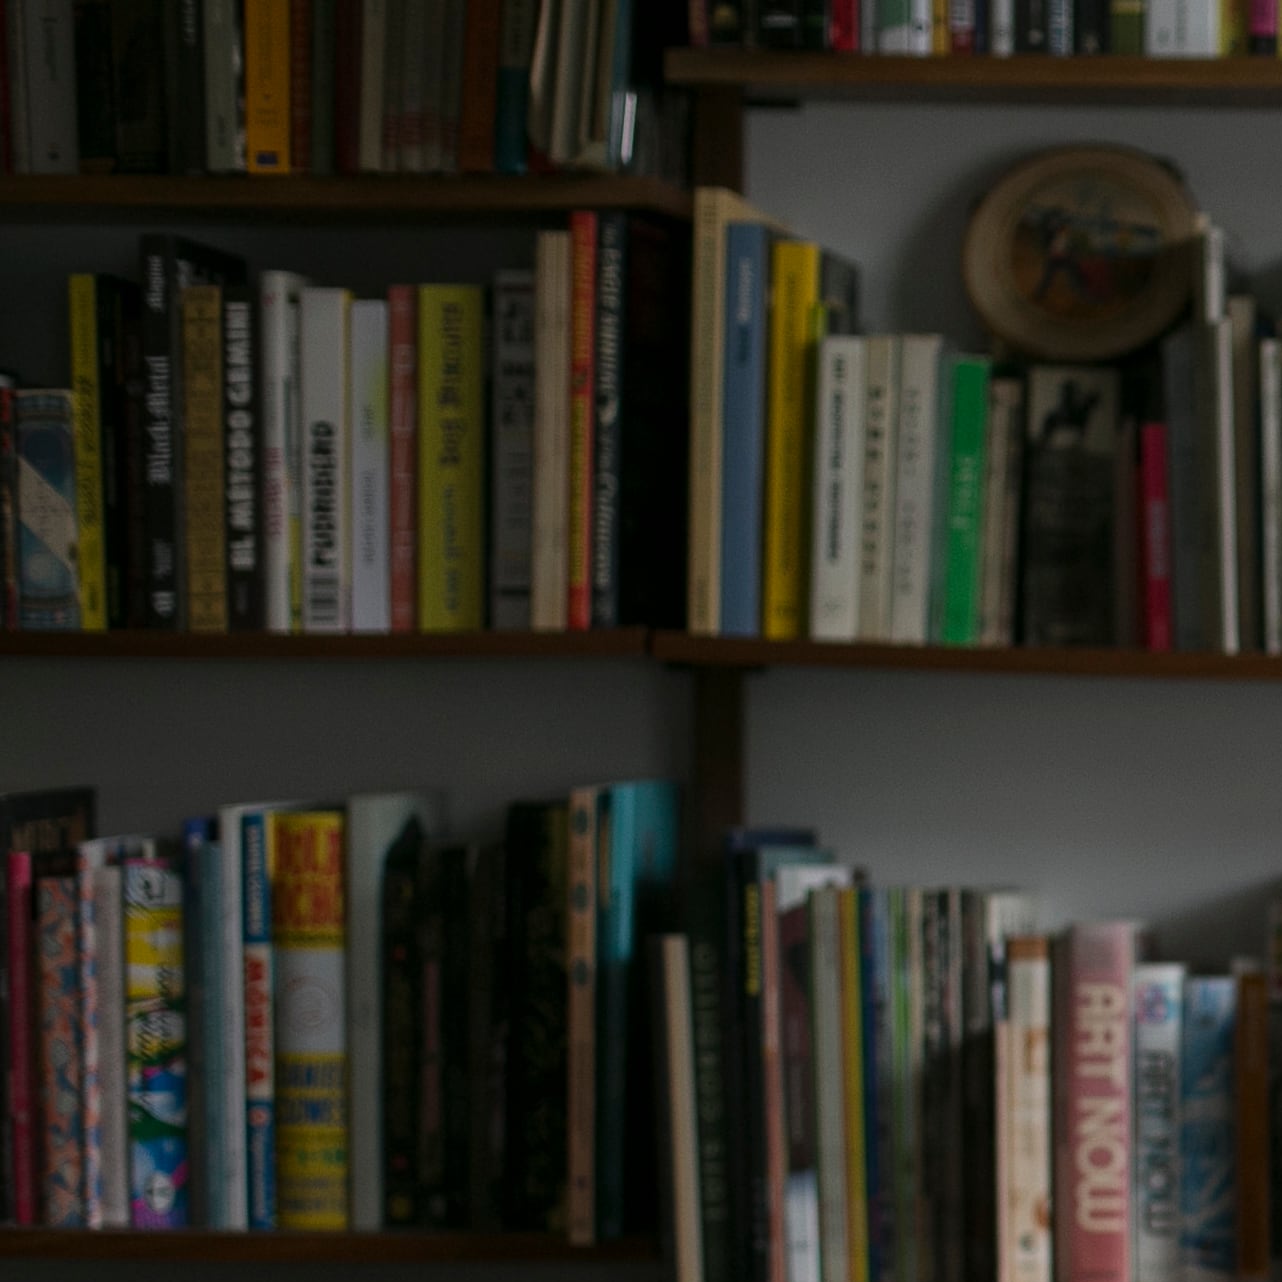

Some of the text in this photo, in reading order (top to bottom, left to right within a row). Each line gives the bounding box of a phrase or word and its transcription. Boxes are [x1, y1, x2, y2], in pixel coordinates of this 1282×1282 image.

[227, 302, 252, 404] GEMINI
[230, 537, 254, 570] EL
[1075, 982, 1126, 1233] ART NOW
